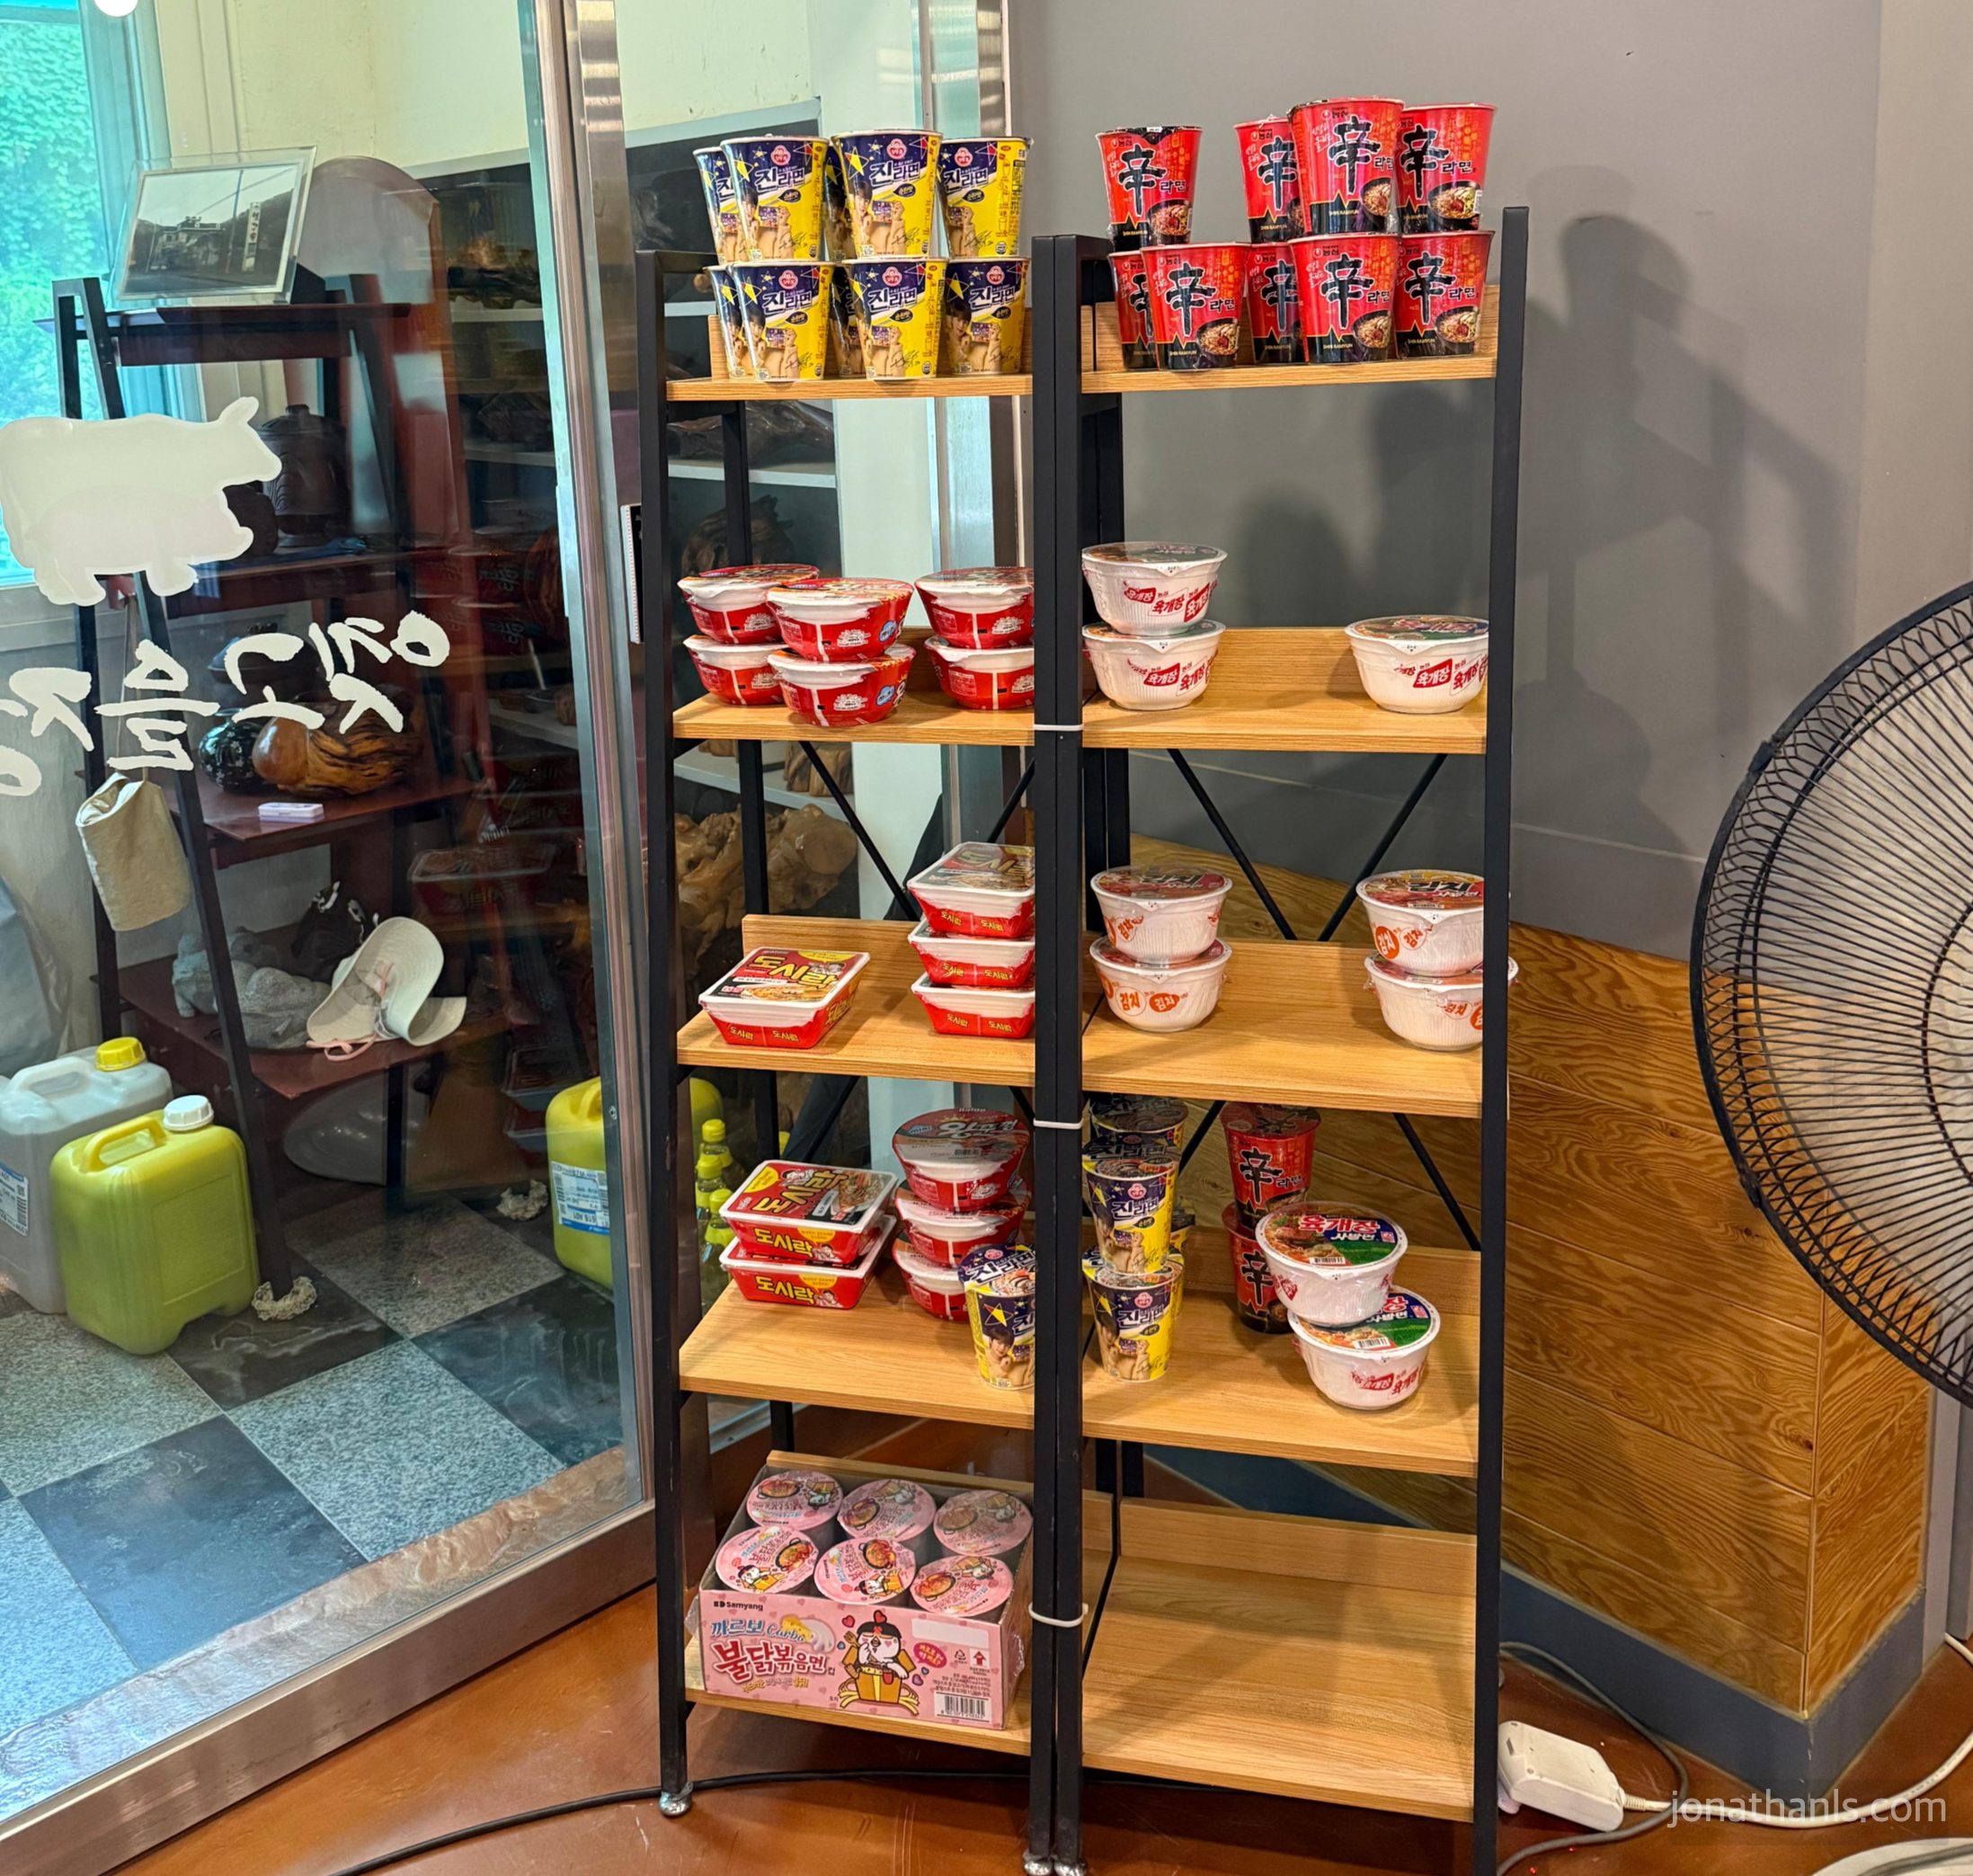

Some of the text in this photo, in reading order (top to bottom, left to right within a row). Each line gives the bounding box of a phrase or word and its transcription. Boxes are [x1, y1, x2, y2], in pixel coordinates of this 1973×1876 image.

[1328, 114, 1382, 195] 辛
[1400, 123, 1450, 200] 辛
[755, 167, 805, 192] 진라면
[869, 161, 920, 187] 진라면
[1441, 161, 1472, 174] 라면
[944, 167, 989, 193] 진라면
[1118, 143, 1167, 218] 辛
[1160, 180, 1186, 194] 라면
[969, 285, 1015, 310] 진라면
[1165, 262, 1217, 337] 辛
[1320, 253, 1374, 330] 辛
[1404, 251, 1457, 325] 辛
[1448, 286, 1476, 301] 라면
[762, 290, 812, 315] 진라면
[867, 288, 917, 313] 진라면
[1209, 298, 1236, 313] 라면
[1152, 595, 1185, 614] 육개장
[1148, 670, 1178, 684] 육개장
[1179, 662, 1205, 690] 육개장
[1416, 664, 1451, 687] 육개장
[1453, 661, 1479, 690] 육개장
[981, 919, 1004, 932] 도시락
[749, 955, 839, 991] 도시락
[984, 969, 1009, 981] 도시락
[1119, 991, 1141, 1011] 김치
[1154, 993, 1176, 1010] 김치
[947, 1013, 968, 1027] 도시락
[988, 1020, 1012, 1033] 도시락
[729, 1027, 754, 1041] 도시락
[772, 1029, 799, 1043] 도시락
[1239, 1146, 1283, 1205] 辛
[1275, 1175, 1303, 1189] 라면
[751, 1170, 849, 1214] 도시락
[1111, 1196, 1159, 1219] 진라면
[1298, 1214, 1381, 1233] 육개장
[754, 1227, 814, 1258] 도시락
[1330, 1232, 1375, 1241] 사발면
[1240, 1249, 1275, 1306] 辛
[754, 1275, 815, 1305] 도시락
[1117, 1304, 1165, 1328] 진라면
[726, 1601, 763, 1612] Samyang
[711, 1618, 805, 1643] 까르보 Carbo
[711, 1639, 827, 1685] 불닭볶음면
[827, 1667, 836, 1676] 컵
